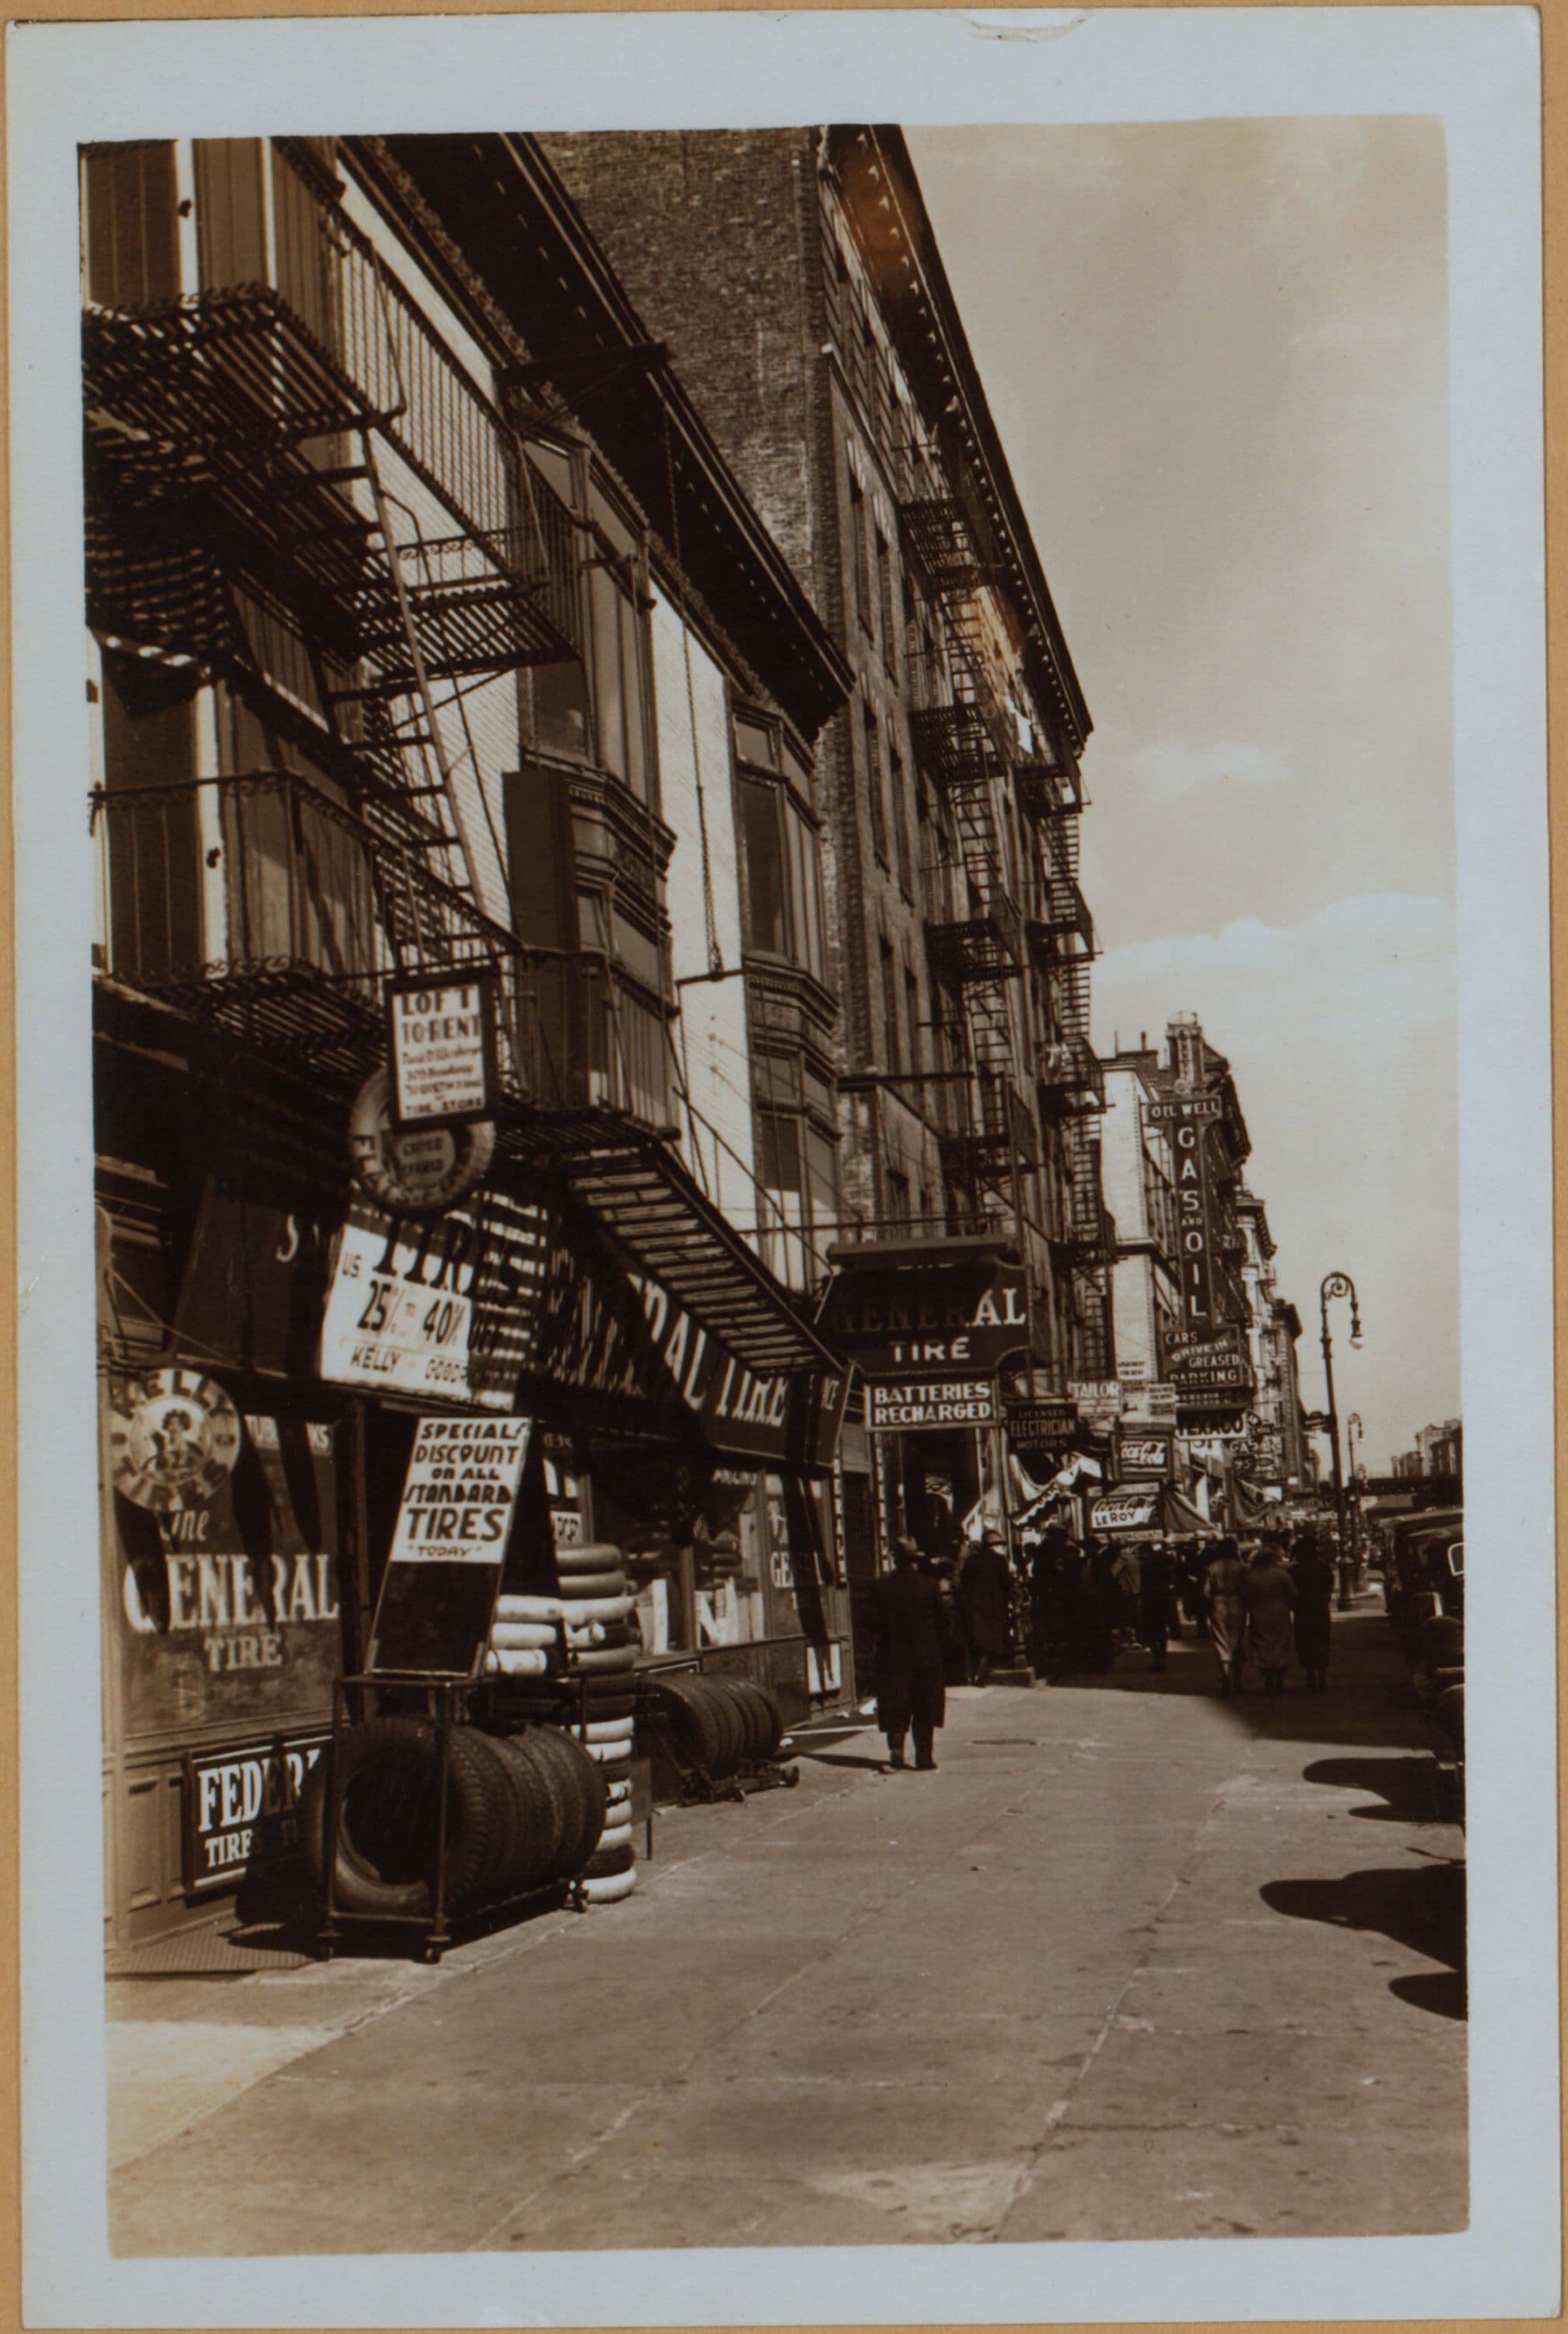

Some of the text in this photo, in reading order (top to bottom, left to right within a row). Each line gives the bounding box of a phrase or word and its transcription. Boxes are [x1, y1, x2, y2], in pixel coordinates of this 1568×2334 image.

[402, 986, 470, 1014] LOFT
[1150, 1097, 1220, 1118] OIL WELL
[422, 1299, 466, 1345] 40%
[1166, 1332, 1198, 1345] CARS
[1215, 1338, 1228, 1352] IN
[350, 1345, 401, 1373] KELLY
[888, 1336, 971, 1363] TIRE
[1188, 1354, 1240, 1368] GREASED
[1170, 1370, 1237, 1383] PARKING
[873, 1382, 991, 1405] BATTERIES
[1067, 1381, 1119, 1398] TAILOR
[874, 1401, 991, 1424] RECHARGED
[1010, 1419, 1075, 1438] ELECTRICIAN
[415, 1445, 519, 1464] DISCOUNT
[460, 1468, 499, 1479] ALL
[404, 1484, 512, 1504] STANDARD
[407, 1508, 506, 1541] TIRES
[1095, 1510, 1136, 1526] LEROY
[204, 1634, 282, 1671] TIRE
